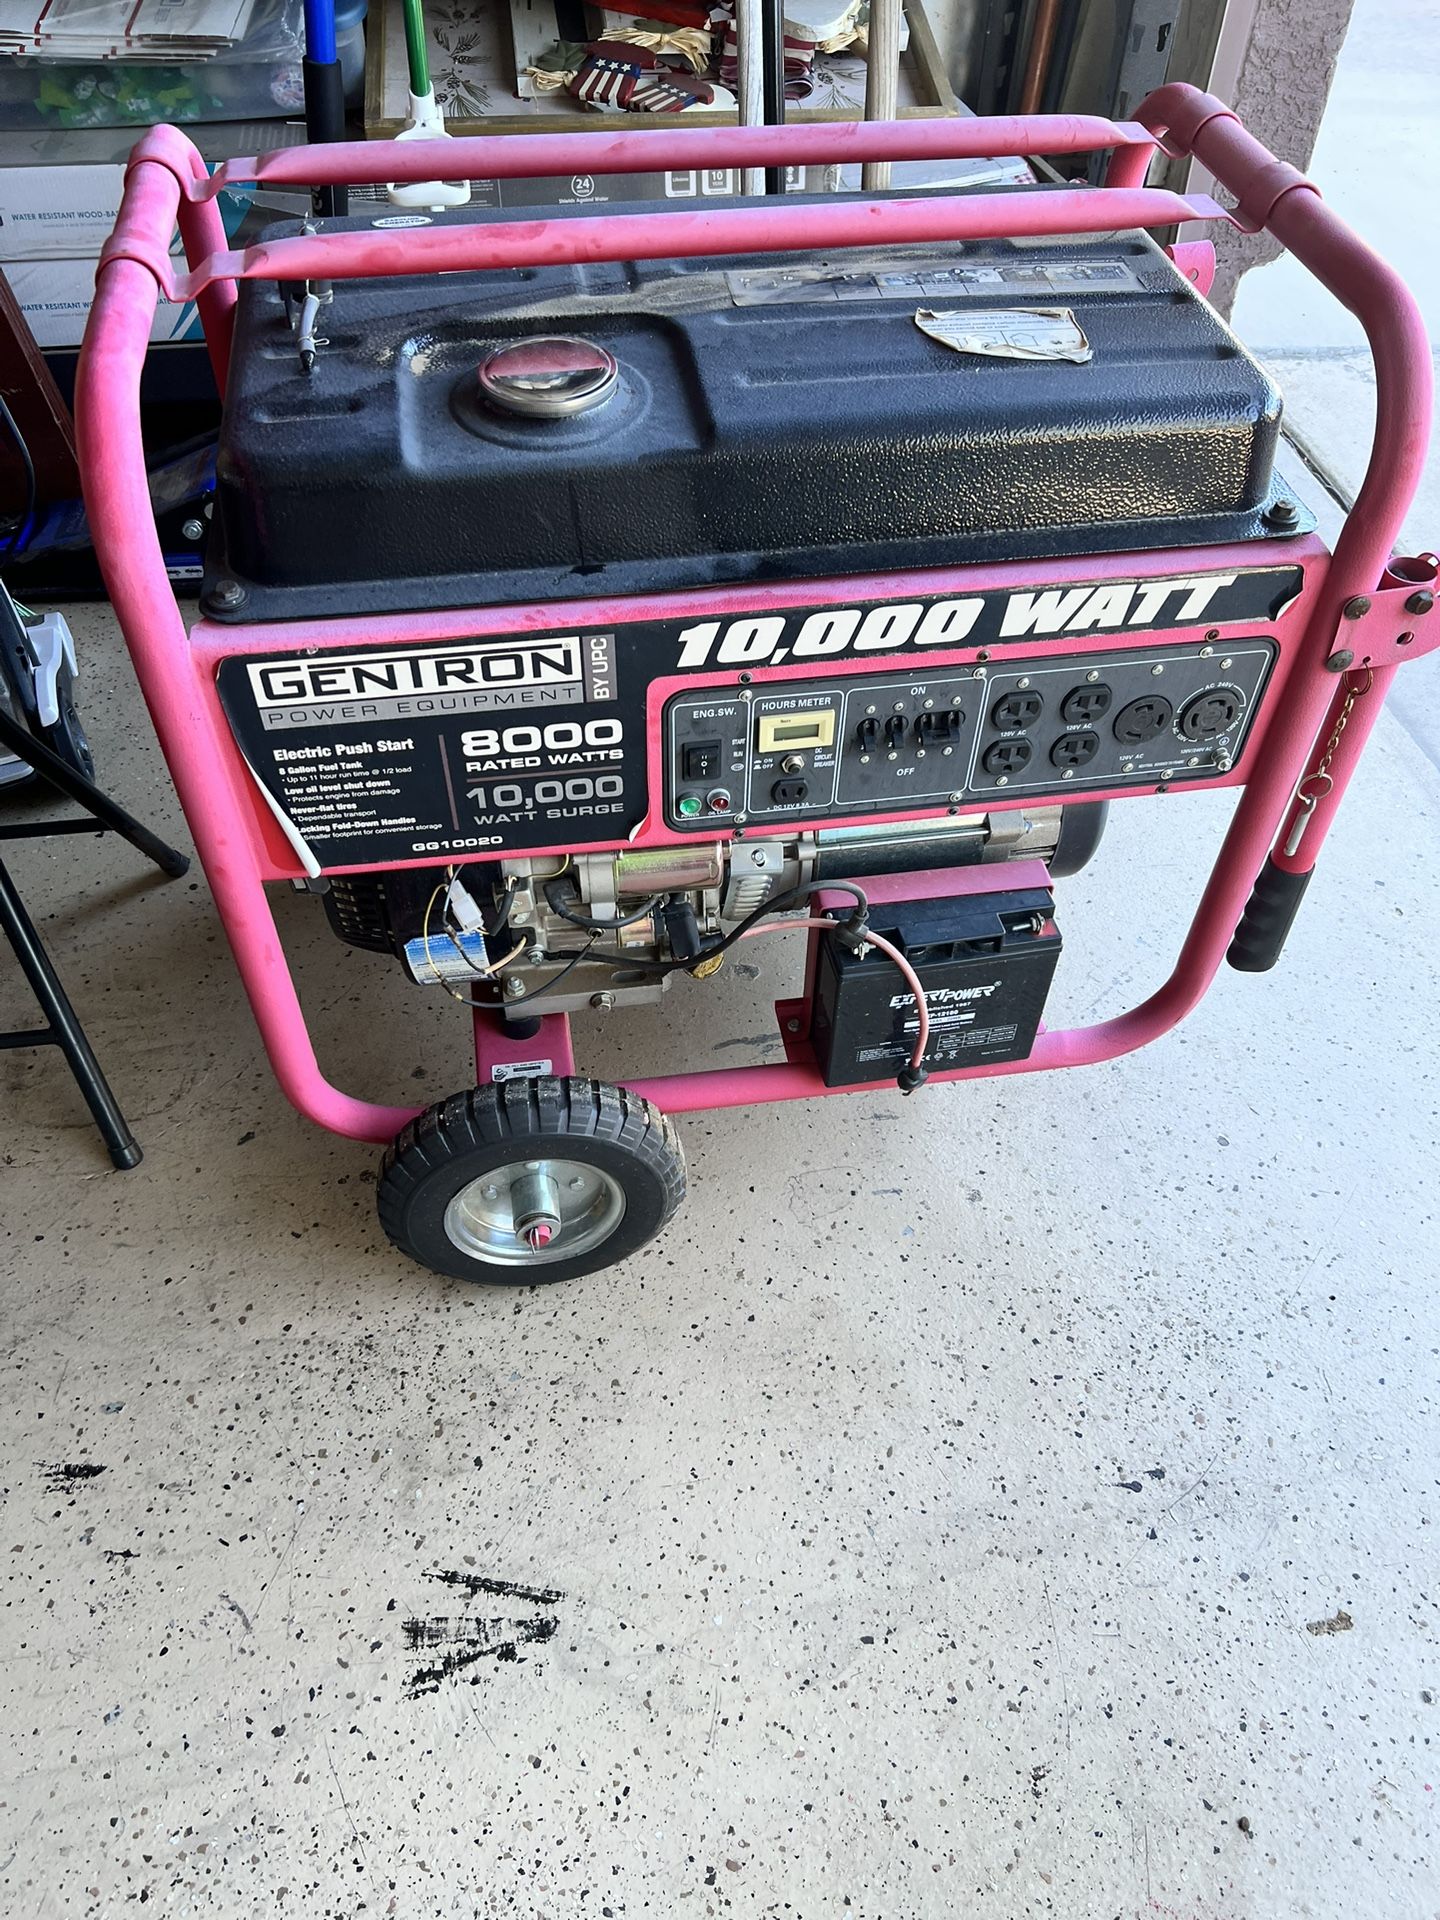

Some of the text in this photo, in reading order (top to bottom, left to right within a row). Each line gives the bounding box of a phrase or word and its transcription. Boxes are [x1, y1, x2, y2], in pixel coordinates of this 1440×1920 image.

[576, 178, 590, 189] 24
[711, 171, 723, 181] 10
[11, 212, 36, 221] WATER
[38, 211, 75, 220] RESISTANT
[45, 301, 81, 311] RESISTANT
[676, 574, 1239, 669] 10,000 WATT
[259, 644, 573, 701] GENTRON
[590, 637, 610, 700] BY UPC
[910, 686, 927, 696] ON
[267, 687, 578, 725] POWER EQUIPMENT
[761, 697, 832, 711] HOURS METER
[692, 707, 737, 719] ENG.SW.
[460, 718, 623, 757] 8000
[273, 738, 415, 762] Electric Push Start
[278, 761, 363, 775] 8 Gallon Fuel Tank
[465, 749, 624, 773] RATED WATTS
[287, 776, 299, 784] Up
[320, 772, 338, 780] hour
[382, 767, 394, 775] 1/2
[395, 766, 412, 774] load
[896, 767, 916, 777] OFF
[284, 779, 391, 796] Low oil level shut down
[465, 775, 624, 810] 10,000
[292, 788, 401, 803] Protects engine from damage
[290, 802, 358, 815] Never-flat tires
[298, 809, 377, 822] Dependable transport
[473, 803, 624, 825] WATT SURGE
[332, 819, 379, 831] Fold-Down
[381, 817, 417, 826] Handles
[303, 833, 331, 841] Smaller
[332, 829, 362, 838] footprint
[374, 825, 415, 834] convenient
[416, 823, 443, 831] storage
[412, 835, 503, 851] GG10020
